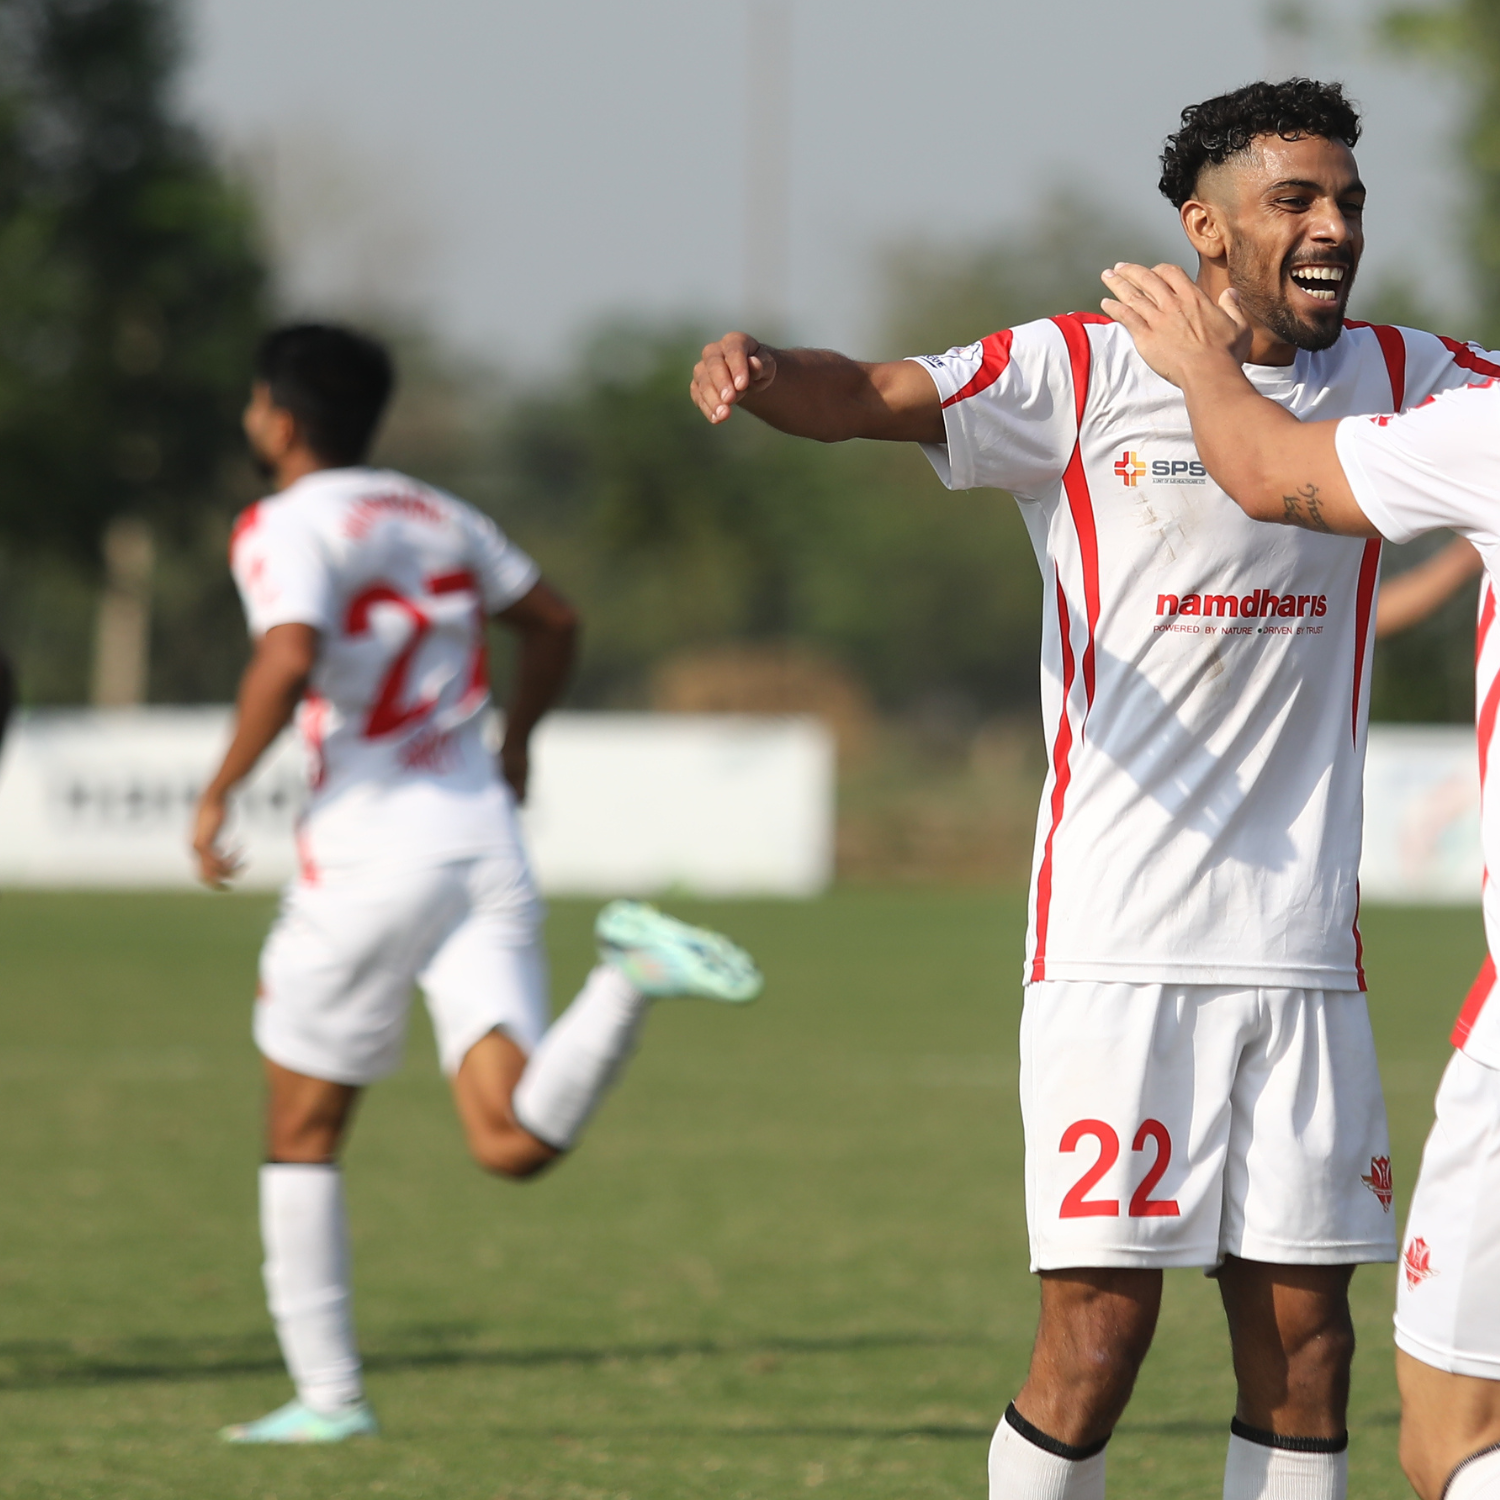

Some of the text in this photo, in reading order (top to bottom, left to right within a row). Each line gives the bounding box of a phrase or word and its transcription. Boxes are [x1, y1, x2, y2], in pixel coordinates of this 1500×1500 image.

[1152, 460, 1206, 476] SPS
[1156, 589, 1327, 618] namdharis
[1153, 624, 1324, 635] POWERED BY NATURE DRIVEN BY TRUST
[1059, 1119, 1181, 1219] 22
